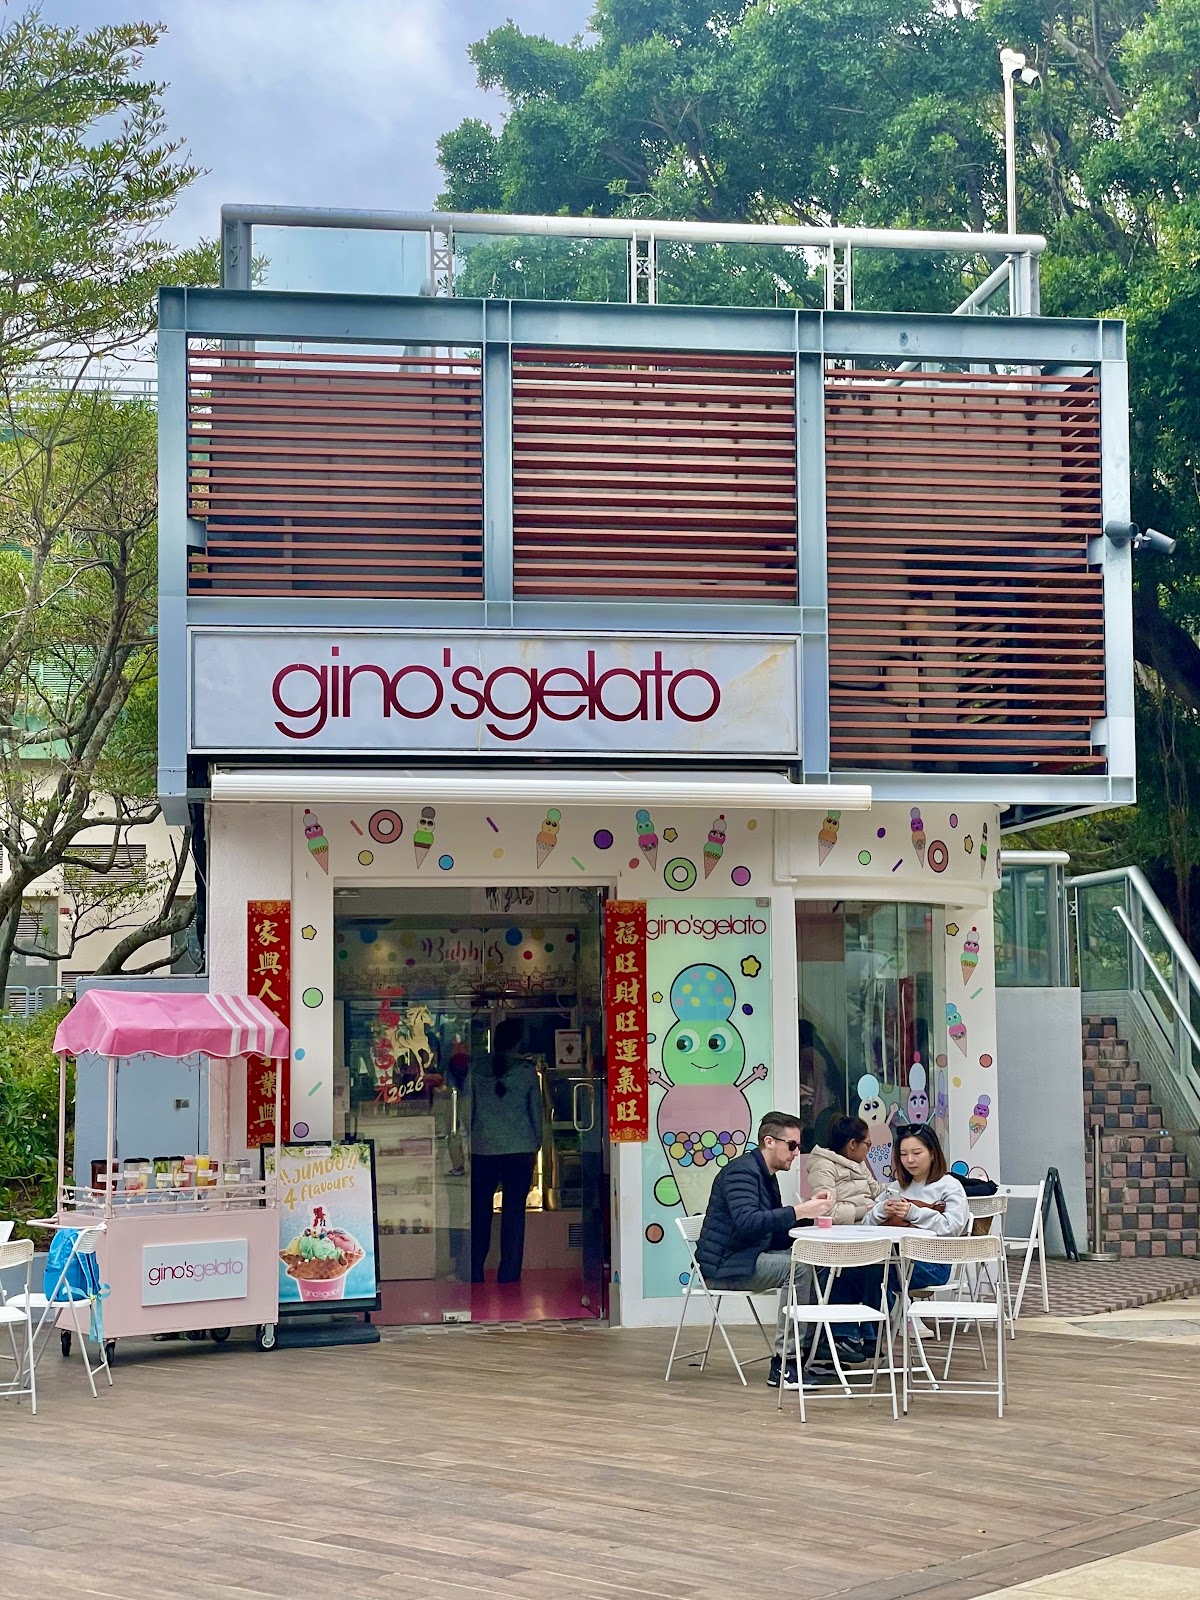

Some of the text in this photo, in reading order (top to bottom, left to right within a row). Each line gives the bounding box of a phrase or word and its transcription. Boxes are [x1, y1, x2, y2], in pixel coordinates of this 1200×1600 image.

[272, 646, 721, 741] gino'sgelato
[614, 920, 642, 1122] 福旺財旺運氣旺
[387, 1075, 425, 1104] 2026
[283, 1175, 356, 1210] 4 flavours
[148, 1257, 244, 1286] gino'sgelato
